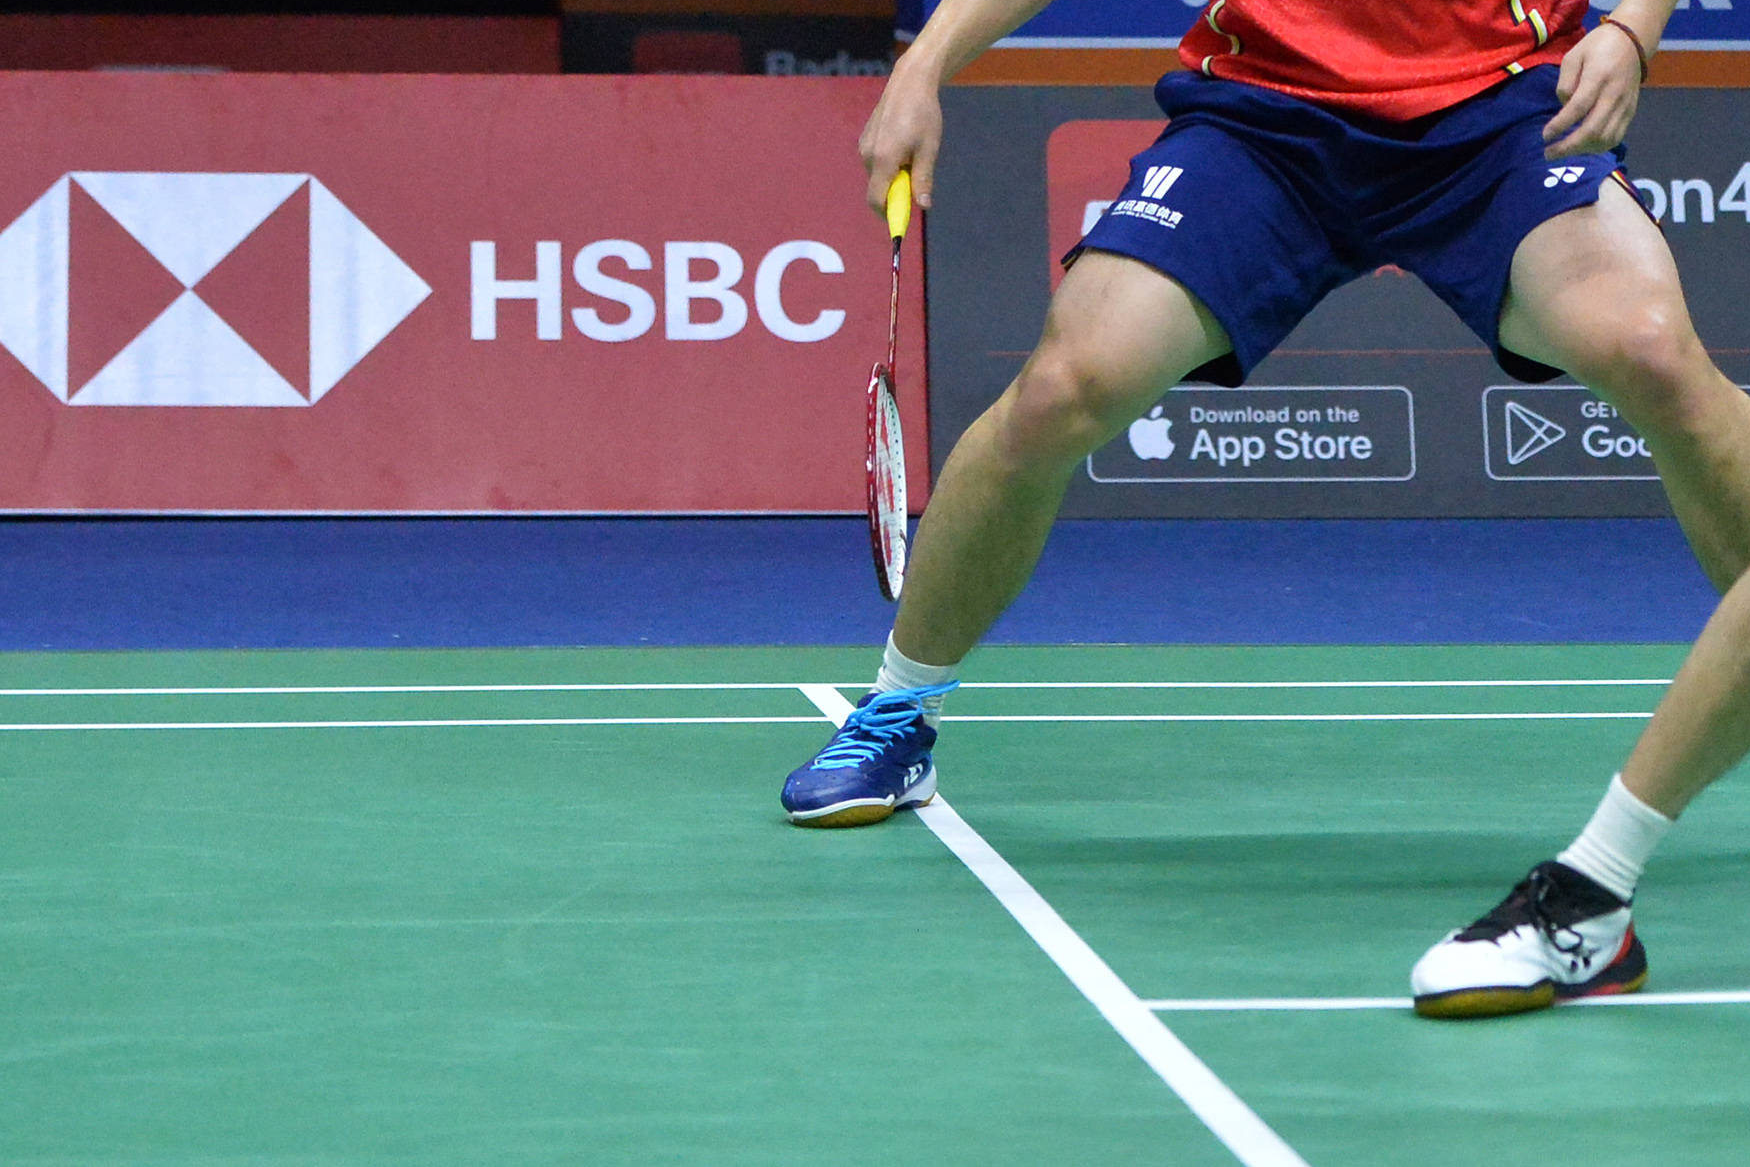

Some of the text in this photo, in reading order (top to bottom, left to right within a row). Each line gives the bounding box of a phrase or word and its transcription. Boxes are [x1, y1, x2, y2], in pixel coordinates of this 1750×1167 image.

[470, 239, 846, 342] HSBC
[1190, 406, 1360, 423] Download on the
[1190, 427, 1372, 467] App Store
